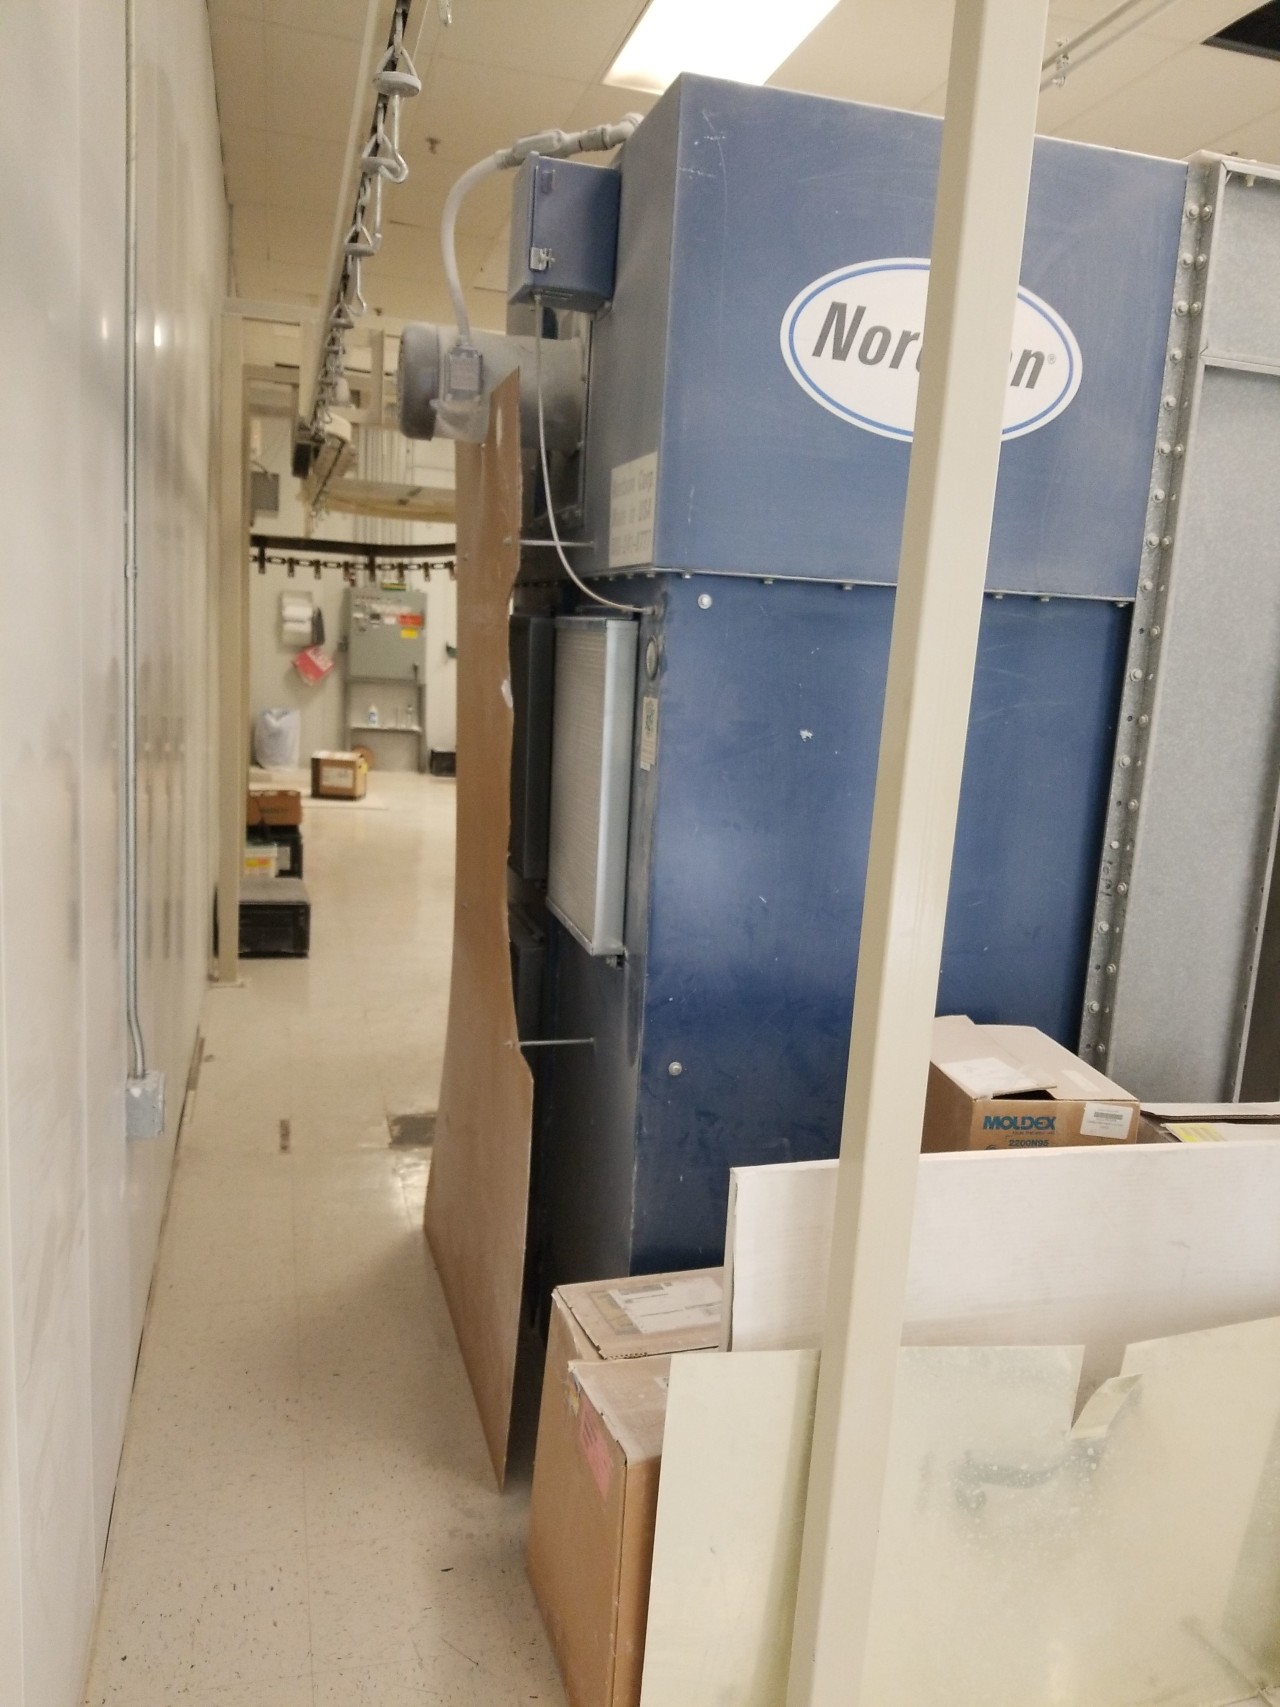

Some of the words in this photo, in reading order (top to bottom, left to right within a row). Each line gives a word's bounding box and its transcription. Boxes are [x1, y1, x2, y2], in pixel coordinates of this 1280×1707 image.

[812, 301, 1045, 389] Norn
[983, 1116, 1056, 1131] MOLDEX
[1008, 1139, 1049, 1147] 2200N95
